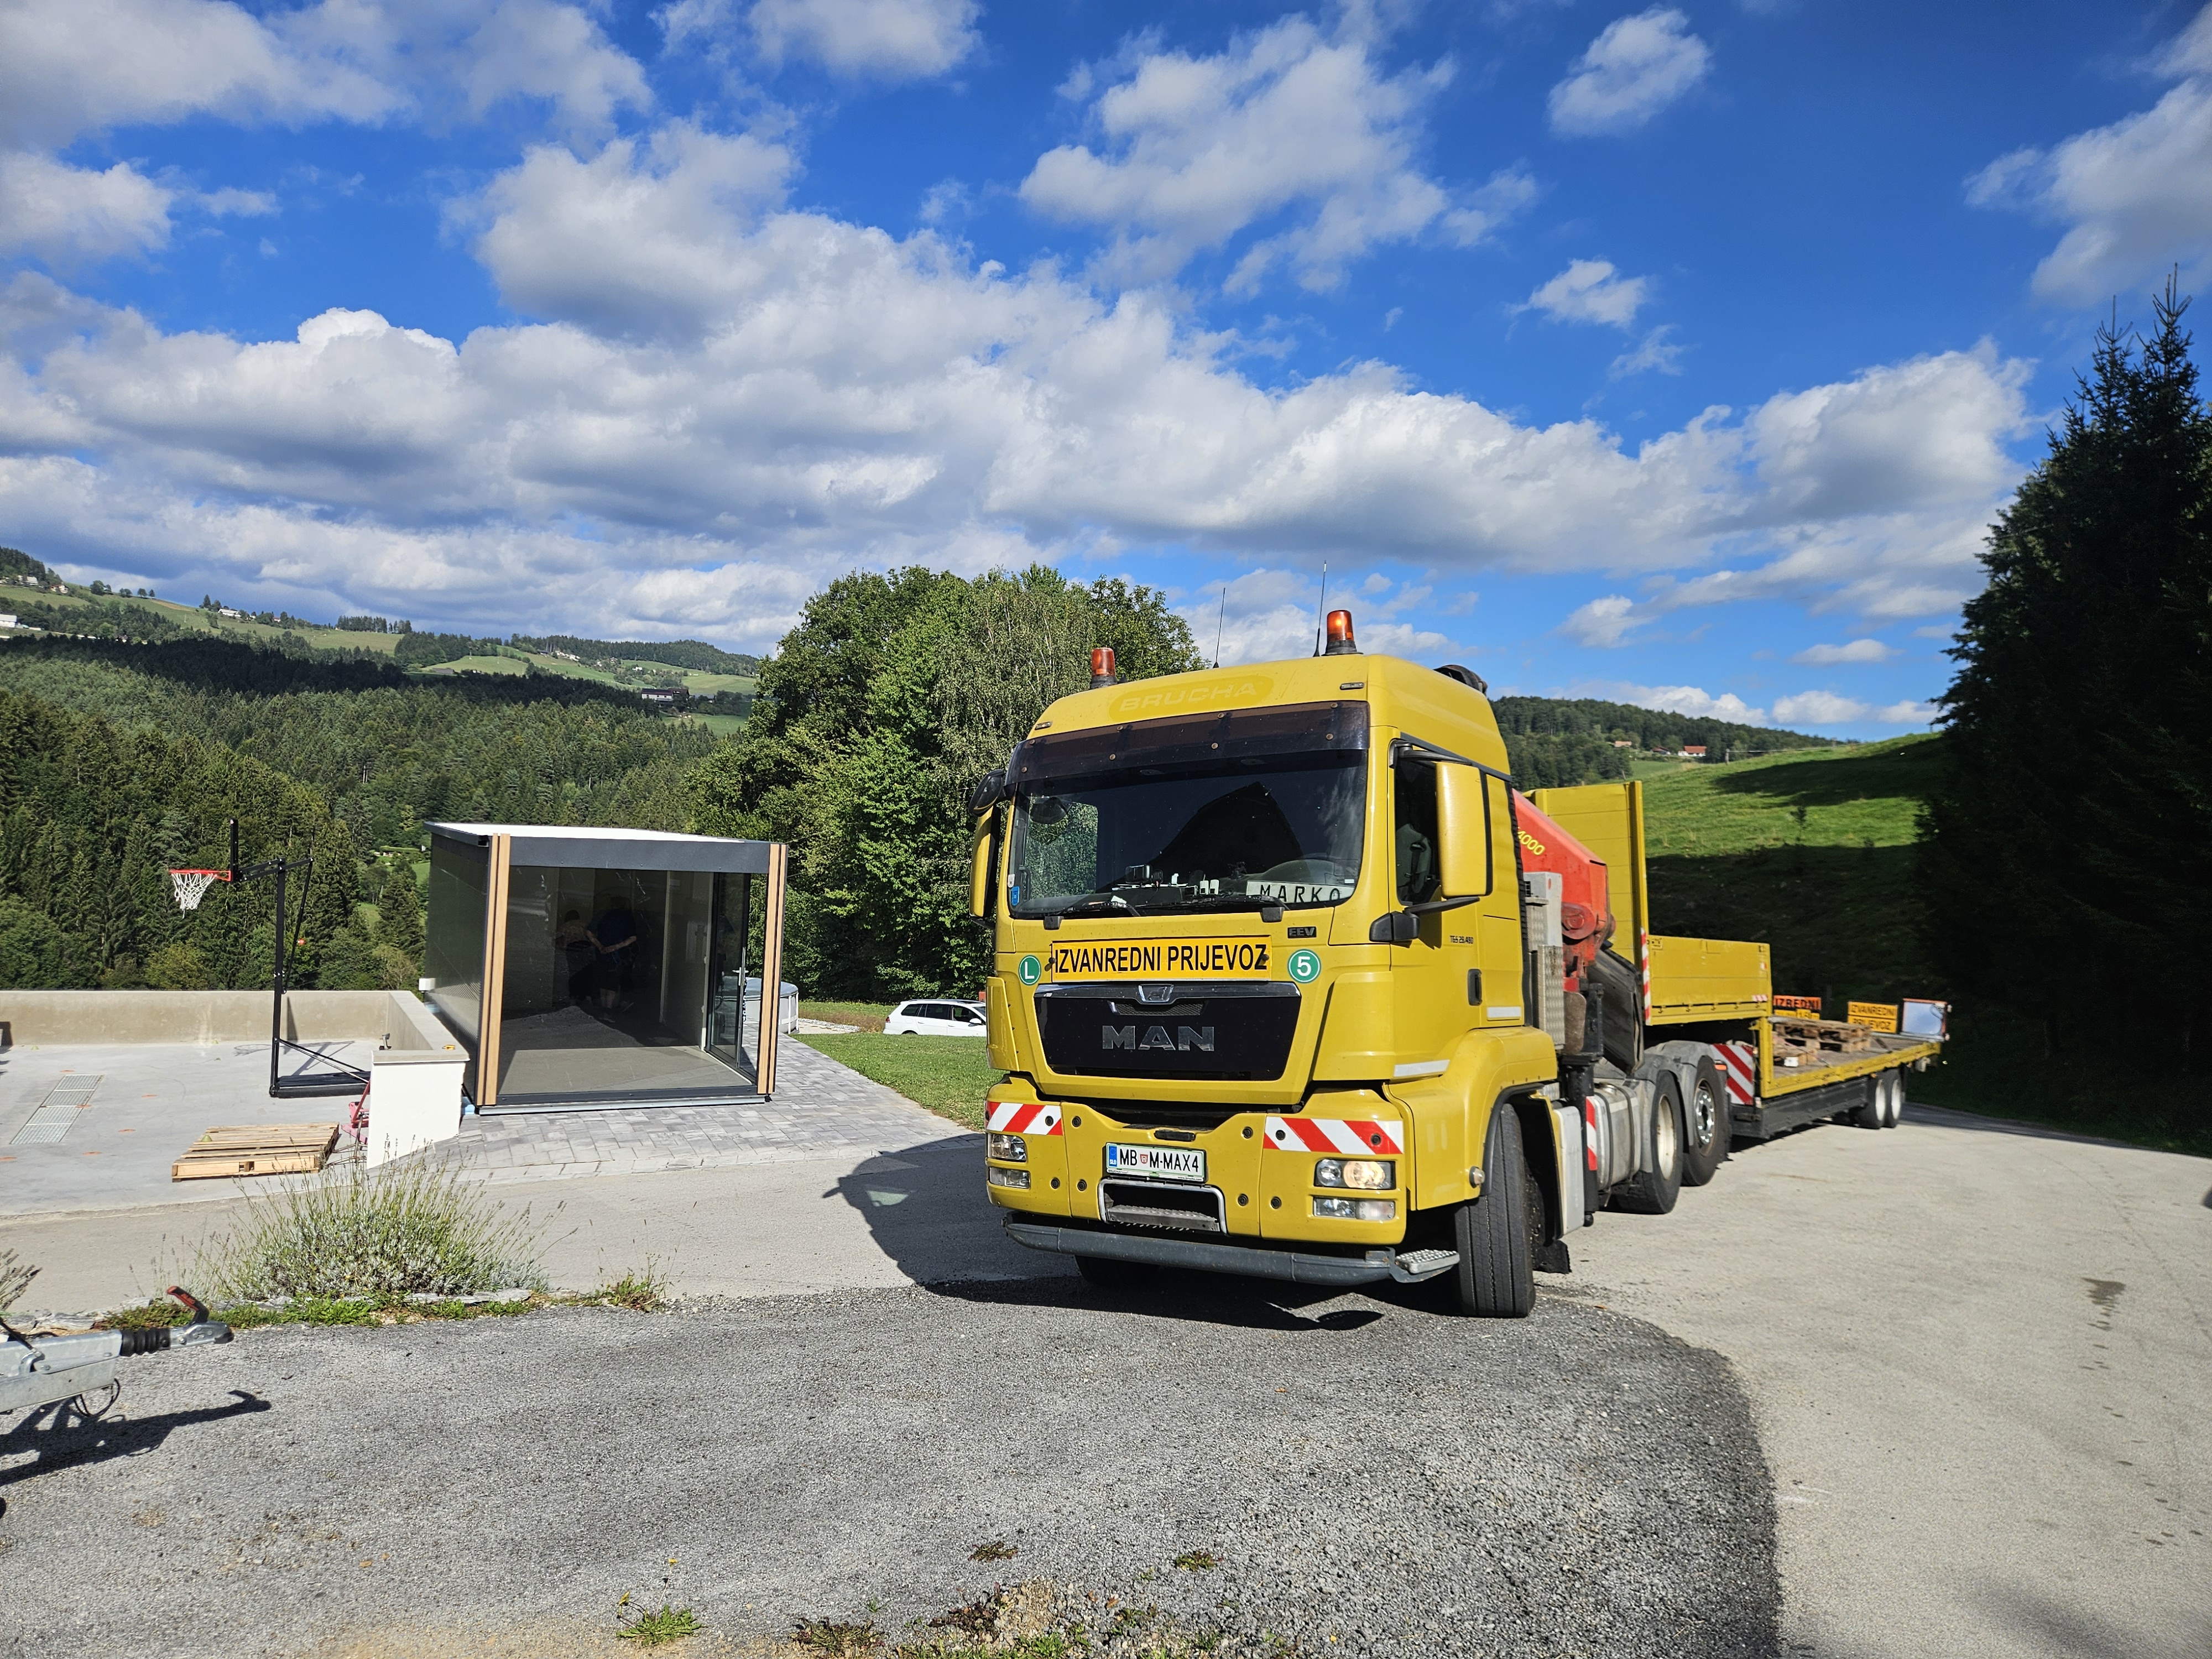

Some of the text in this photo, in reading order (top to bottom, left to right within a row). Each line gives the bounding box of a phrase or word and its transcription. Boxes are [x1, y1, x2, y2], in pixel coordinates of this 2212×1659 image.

[1119, 682, 1257, 712] BRUCHA
[1260, 884, 1340, 903] MARKO
[1288, 927, 1315, 937] EEV
[1055, 944, 1267, 973] IZVANREDNI PRIJEVOZ
[1297, 956, 1312, 977] 5
[1025, 961, 1035, 979] L
[1102, 1025, 1214, 1051] MAN
[1120, 1148, 1199, 1172] MB M-MAX4
